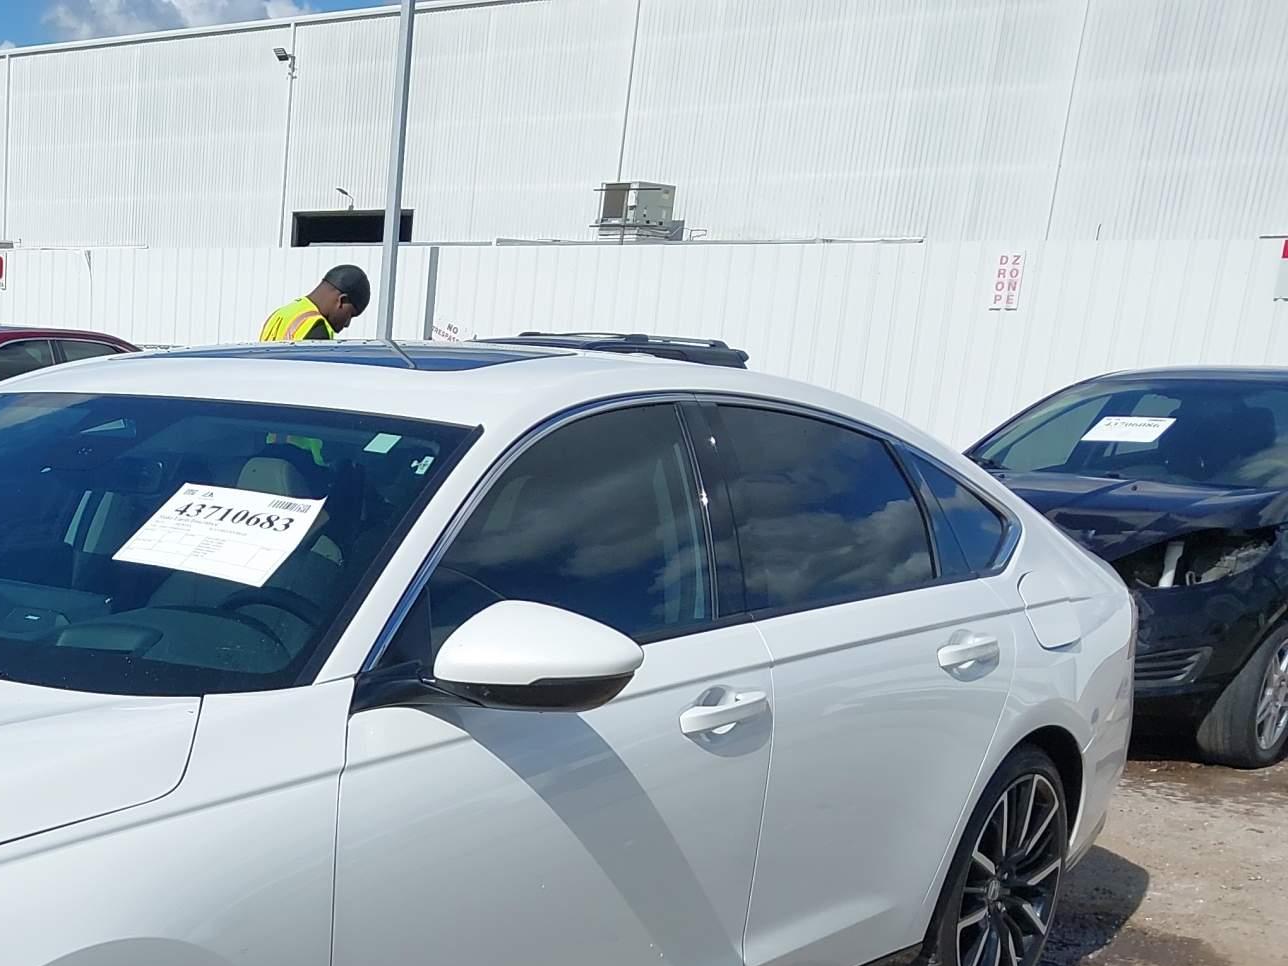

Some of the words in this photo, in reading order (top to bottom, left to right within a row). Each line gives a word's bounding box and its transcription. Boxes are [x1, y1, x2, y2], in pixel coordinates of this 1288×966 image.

[993, 255, 1009, 304] DROP
[1006, 255, 1021, 304] ZONE
[447, 323, 458, 334] NO
[175, 502, 295, 532] 43710683
